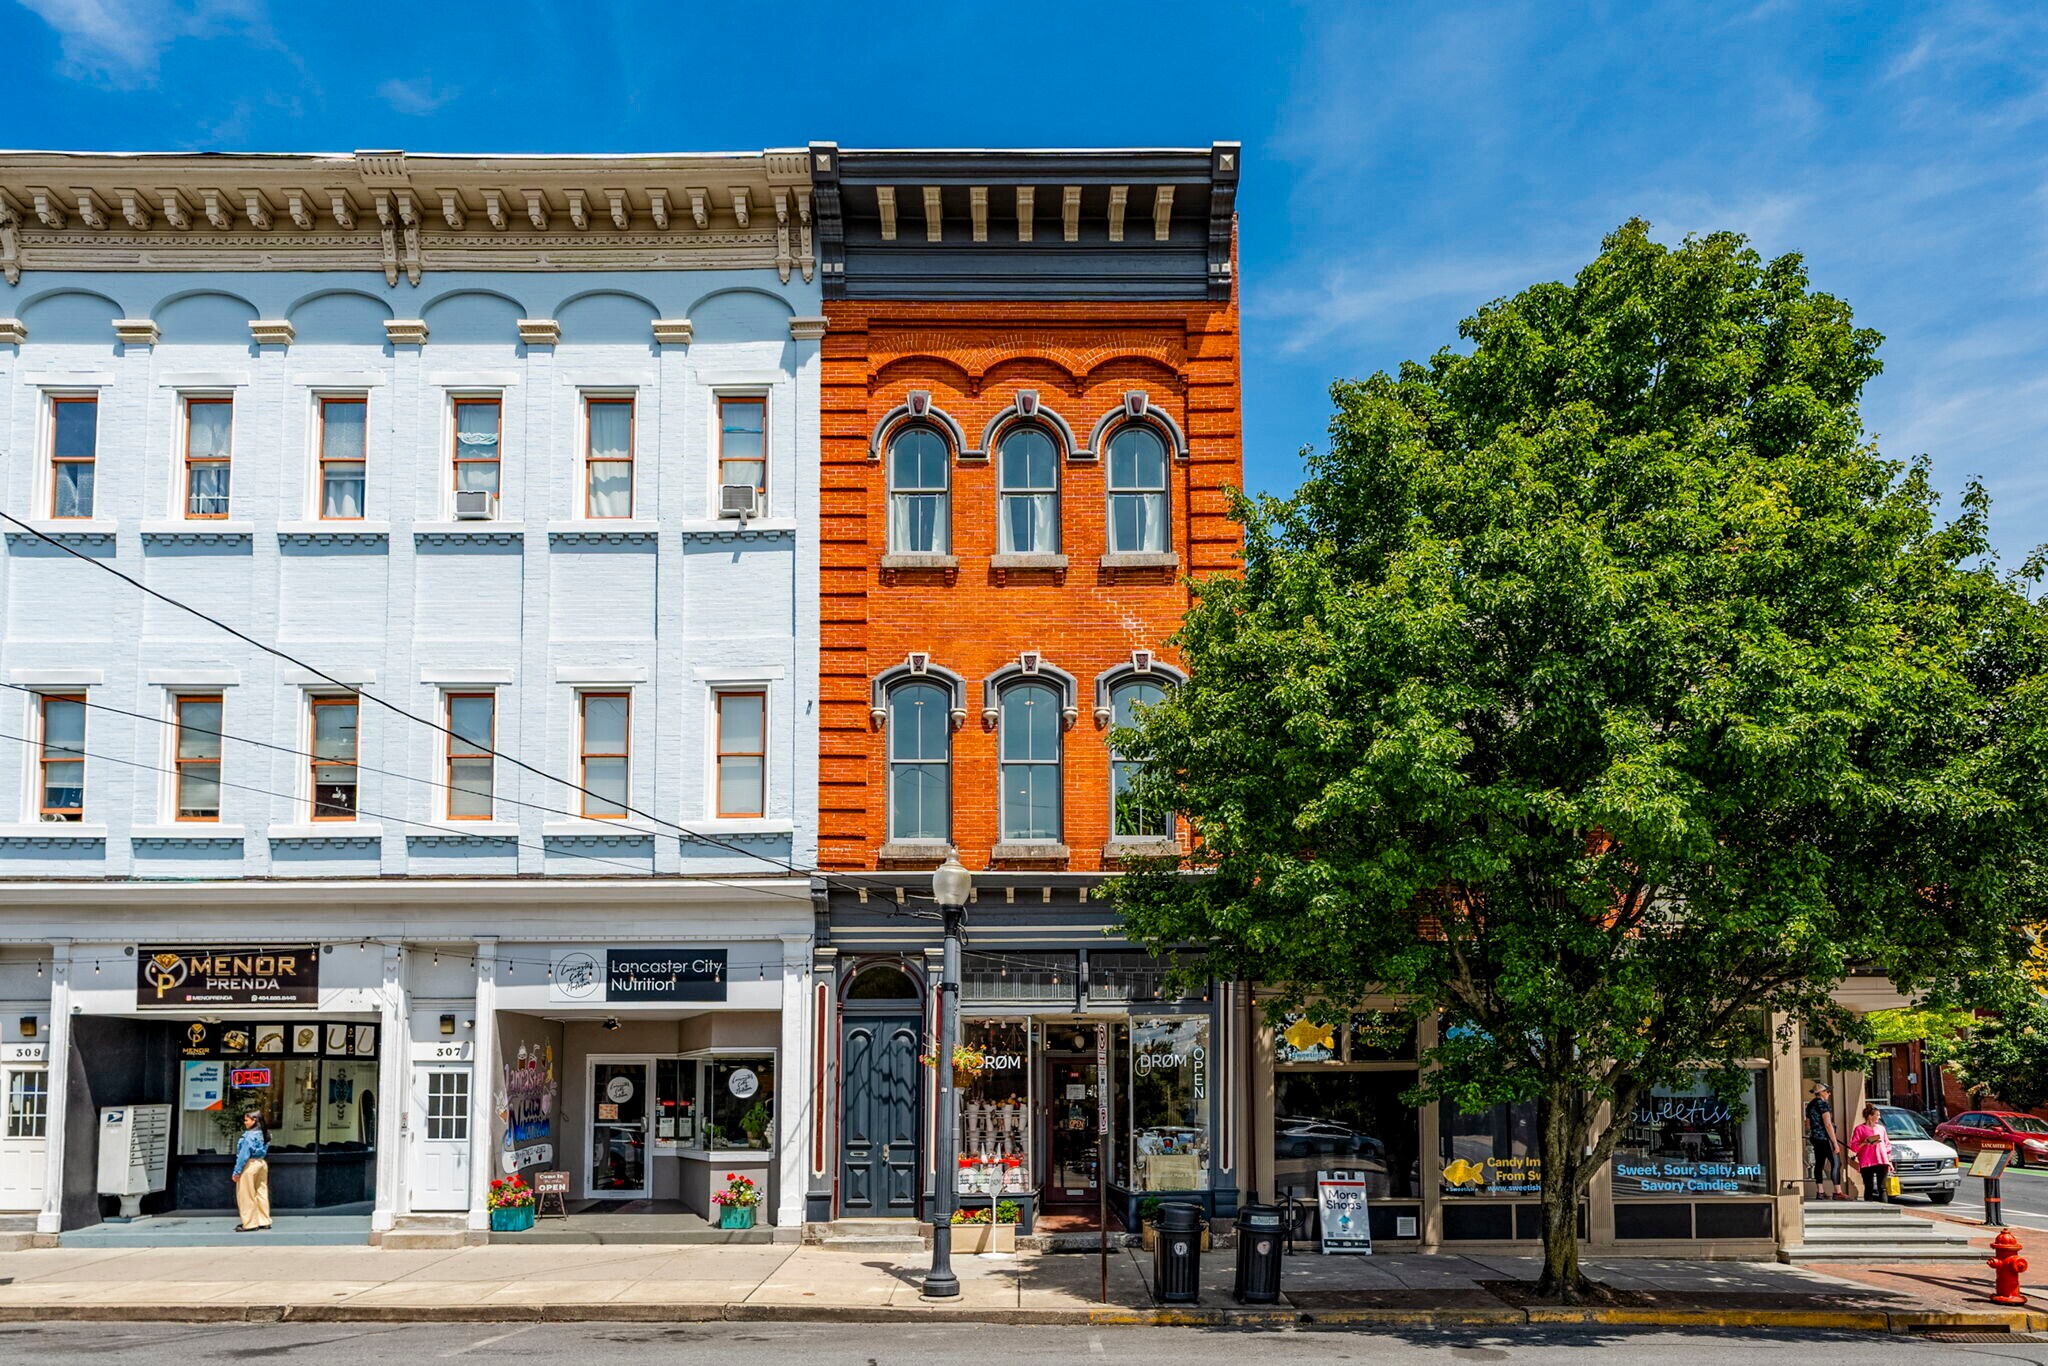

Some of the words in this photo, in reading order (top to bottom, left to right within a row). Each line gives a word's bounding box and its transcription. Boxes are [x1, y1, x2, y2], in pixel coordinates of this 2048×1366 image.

[190, 956, 297, 976] MENOR
[611, 959, 689, 974] Lancaster
[692, 959, 723, 976] City
[206, 978, 281, 991] PRENDA
[611, 977, 676, 992] Nutrition
[16, 1048, 41, 1057] 309
[436, 1047, 461, 1057] 307
[1140, 1053, 1187, 1068] DRØM
[234, 1071, 269, 1085] OPEN
[1193, 1047, 1205, 1099] OPEN
[1487, 1157, 1523, 1169] Candy
[1496, 1171, 1525, 1181] From
[1617, 1164, 1661, 1177] Sweet,
[1664, 1164, 1697, 1177] Sour,
[1700, 1164, 1735, 1178] Salty,
[1737, 1164, 1760, 1175] and
[1640, 1180, 1684, 1193] Savory
[1687, 1180, 1738, 1190] Candies
[1328, 1190, 1357, 1199] More
[1326, 1200, 1361, 1212] Shops
